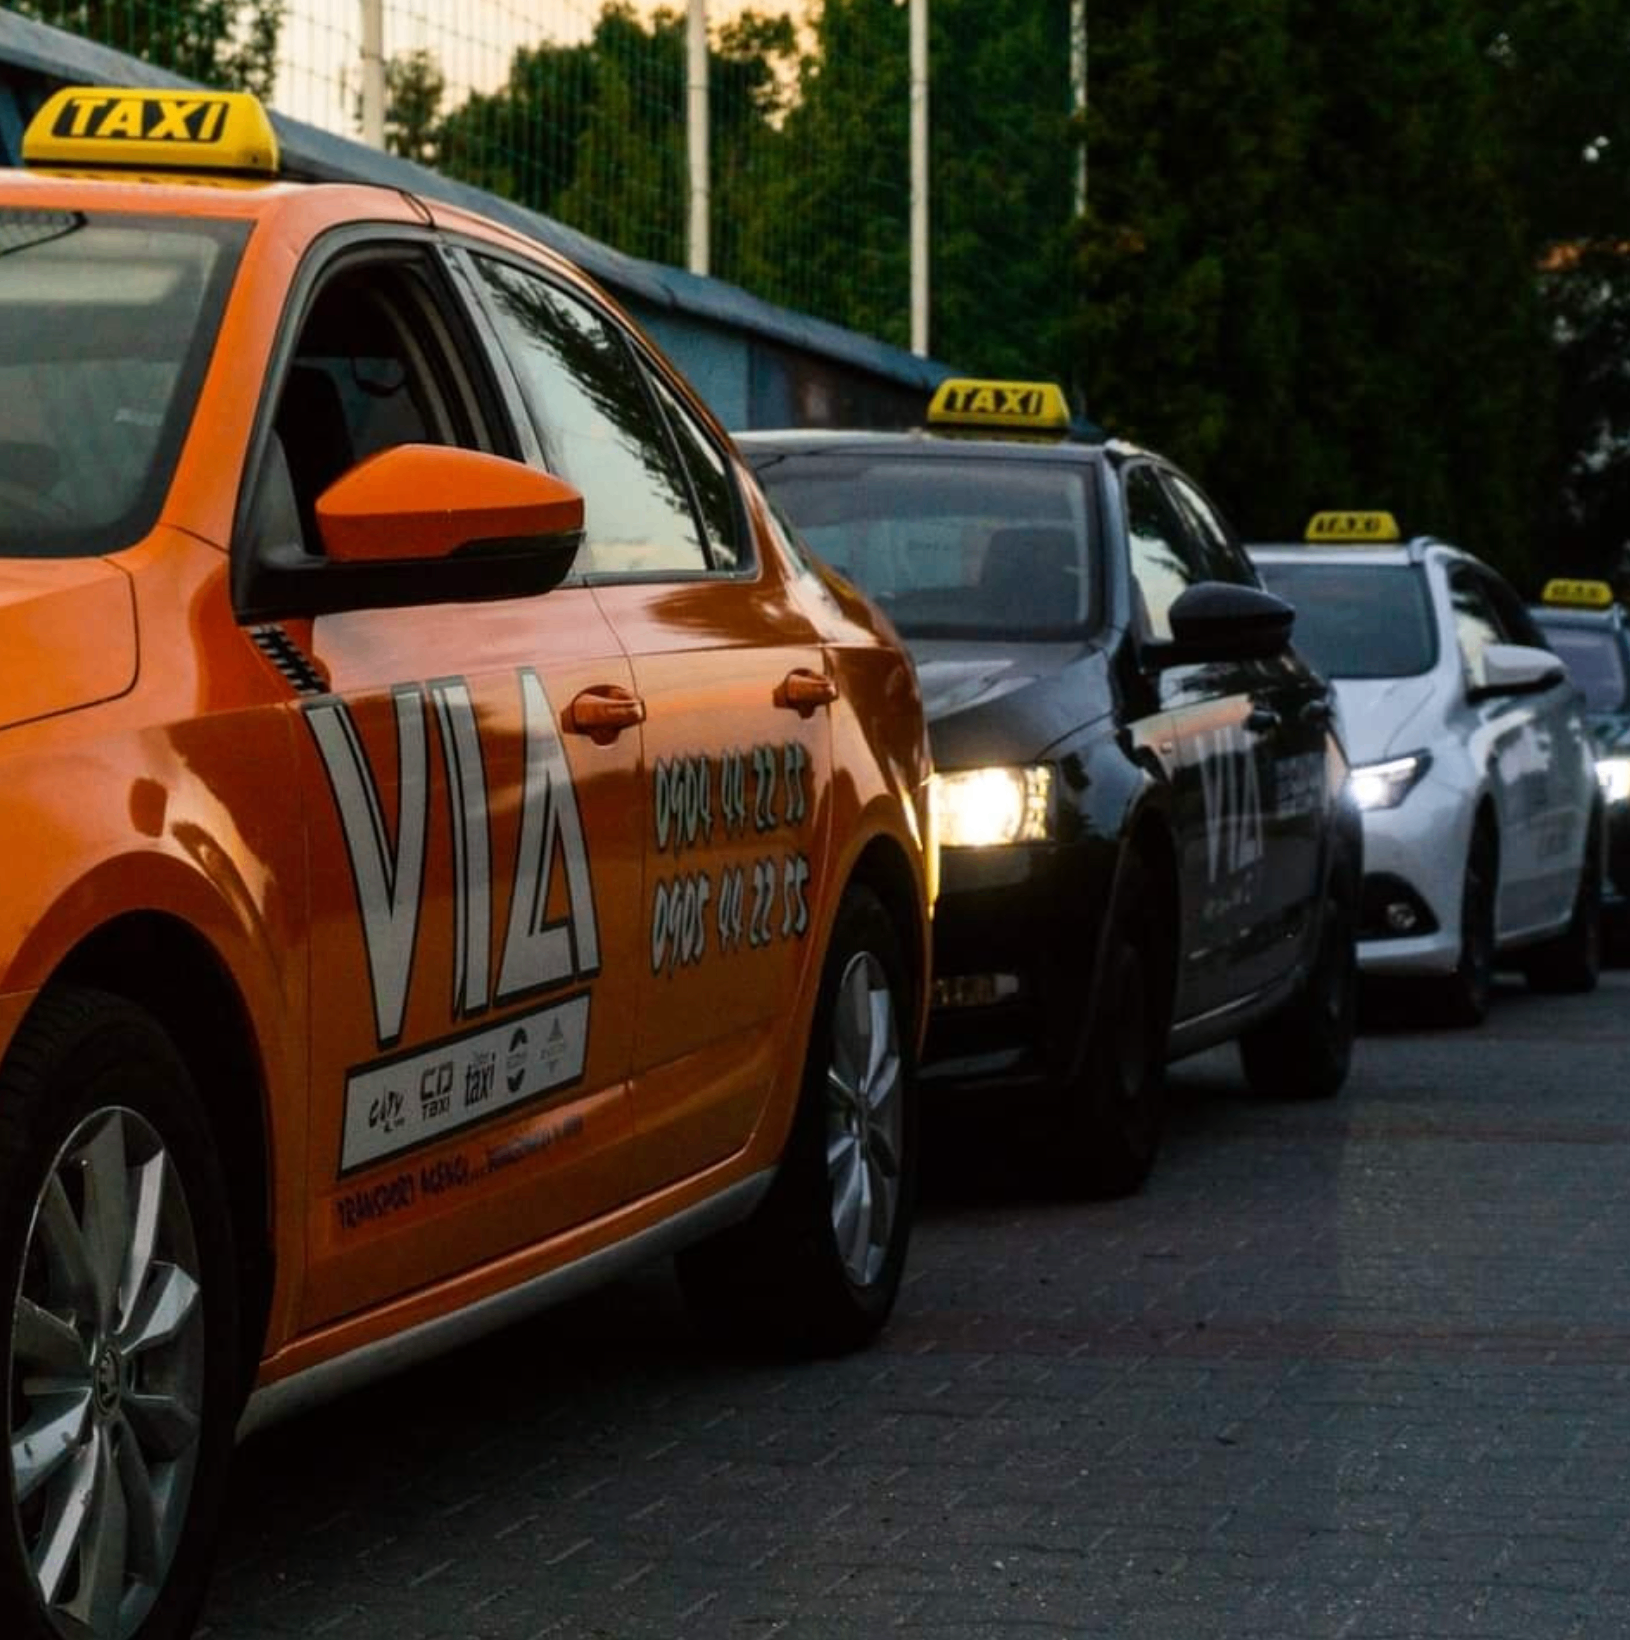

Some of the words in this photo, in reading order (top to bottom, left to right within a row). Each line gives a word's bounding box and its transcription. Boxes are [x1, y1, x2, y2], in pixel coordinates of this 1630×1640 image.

[69, 98, 223, 140] TAXI
[953, 387, 1040, 415] TAXI
[753, 741, 778, 832] 22
[1195, 726, 1262, 882] VIA
[302, 666, 600, 1050] VIA
[652, 873, 711, 981] 0905
[748, 855, 777, 950] 22
